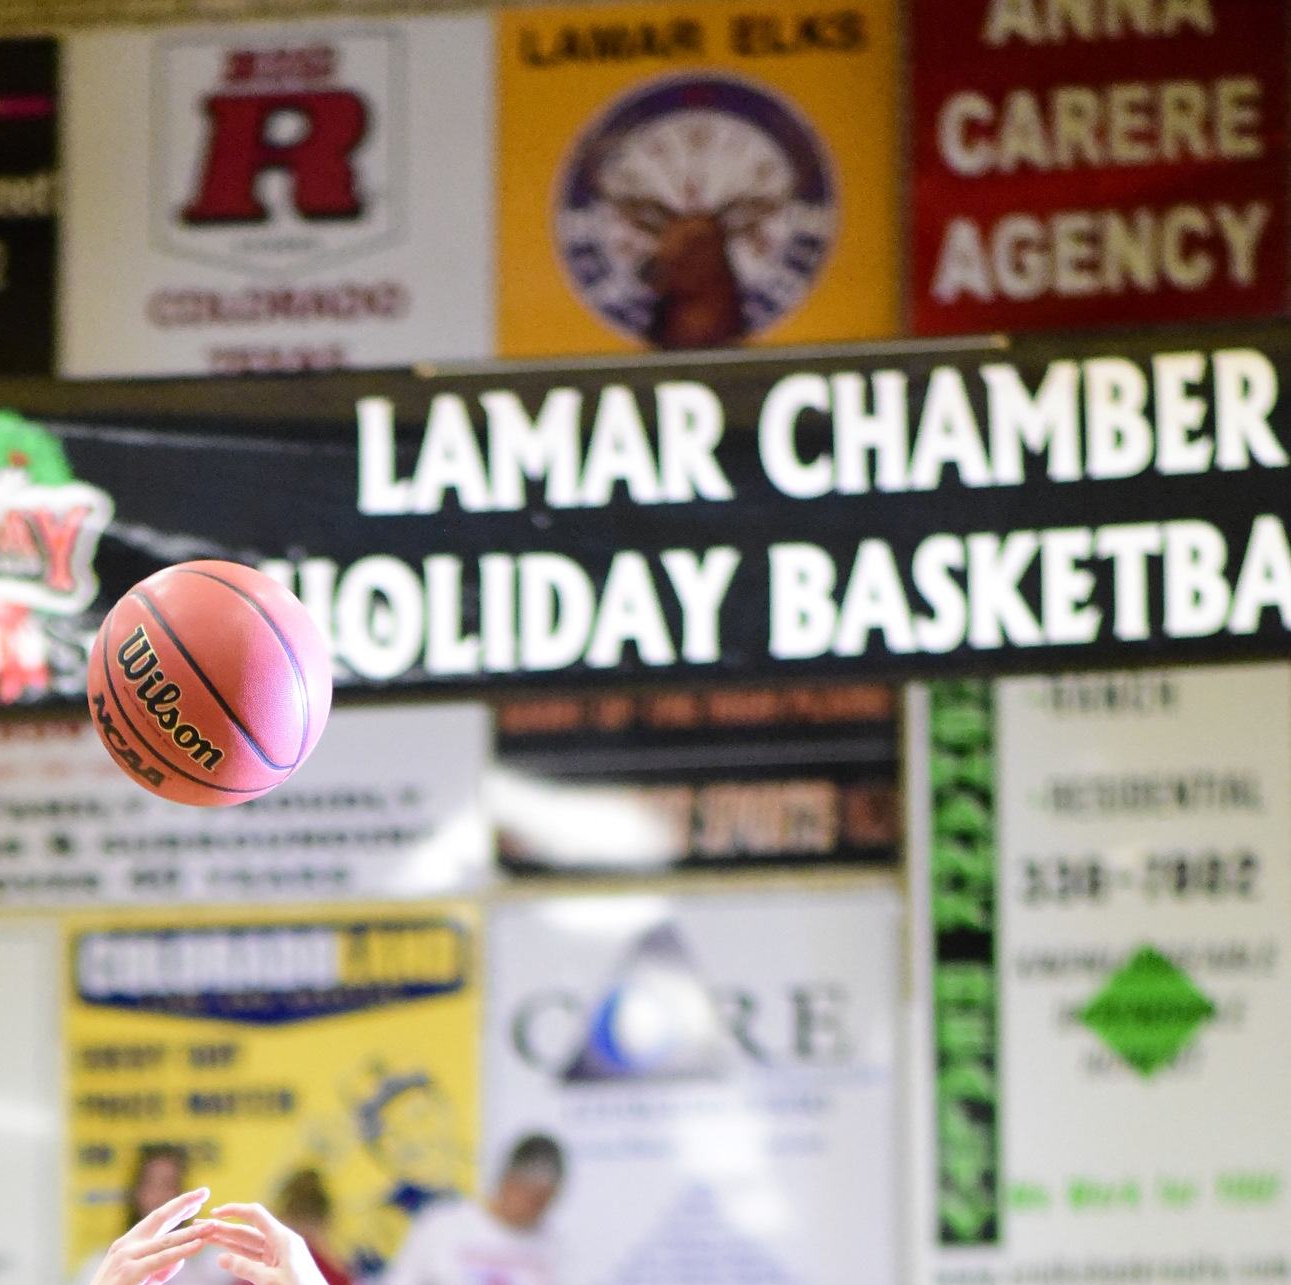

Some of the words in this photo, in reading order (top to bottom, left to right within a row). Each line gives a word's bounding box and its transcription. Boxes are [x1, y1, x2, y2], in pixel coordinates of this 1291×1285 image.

[518, 16, 705, 67] LAMAR
[729, 9, 868, 57] ELKS
[934, 75, 1266, 178] CARERE
[928, 202, 1274, 306] AGENCY
[354, 379, 738, 516] LAMAR
[757, 346, 1291, 500] CHAMBER
[767, 512, 1291, 662] BASKETBA
[92, 693, 167, 789] NCAA
[116, 623, 225, 773] Wilson
